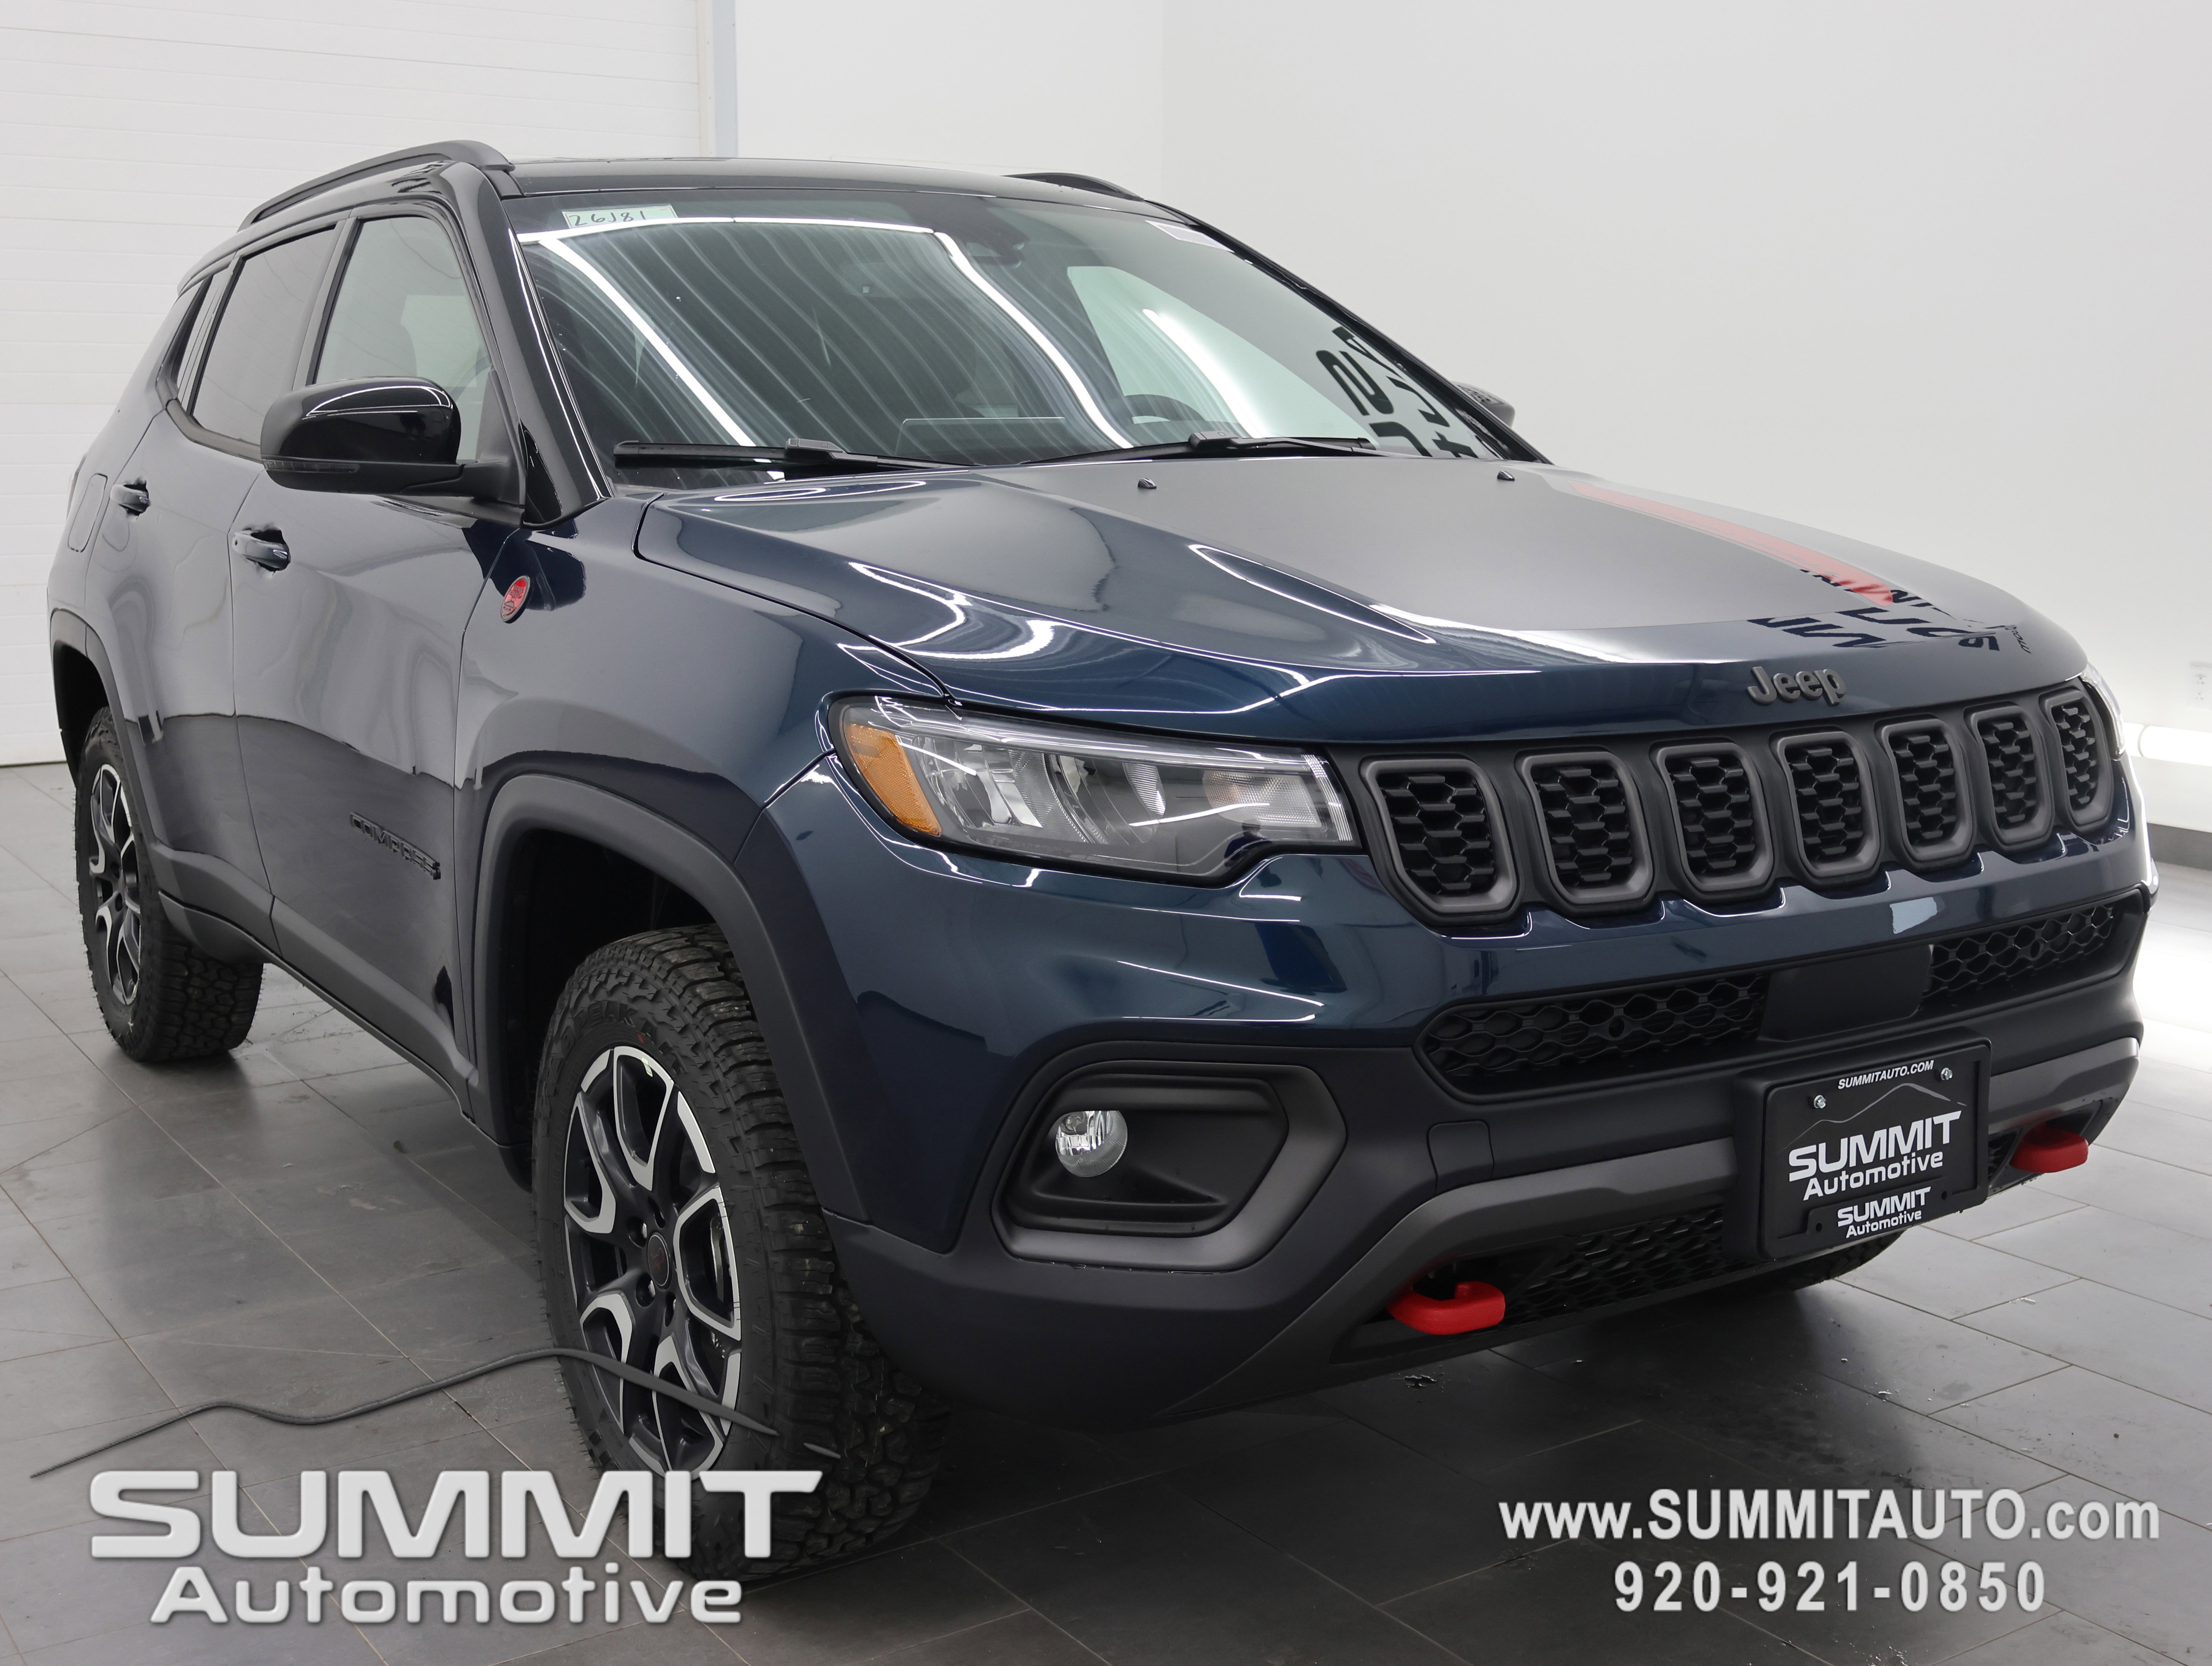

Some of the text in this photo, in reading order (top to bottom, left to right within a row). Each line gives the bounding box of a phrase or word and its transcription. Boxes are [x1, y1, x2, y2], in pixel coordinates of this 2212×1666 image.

[1746, 666, 1846, 707] Jeep
[1837, 1060, 1934, 1089] SUMMITAUTO.COM
[1788, 1110, 1962, 1182] SUMMIT
[1803, 1151, 1944, 1201] Automotive
[1837, 1187, 1931, 1227] SUMMIT
[1845, 1210, 1922, 1238] Automotive
